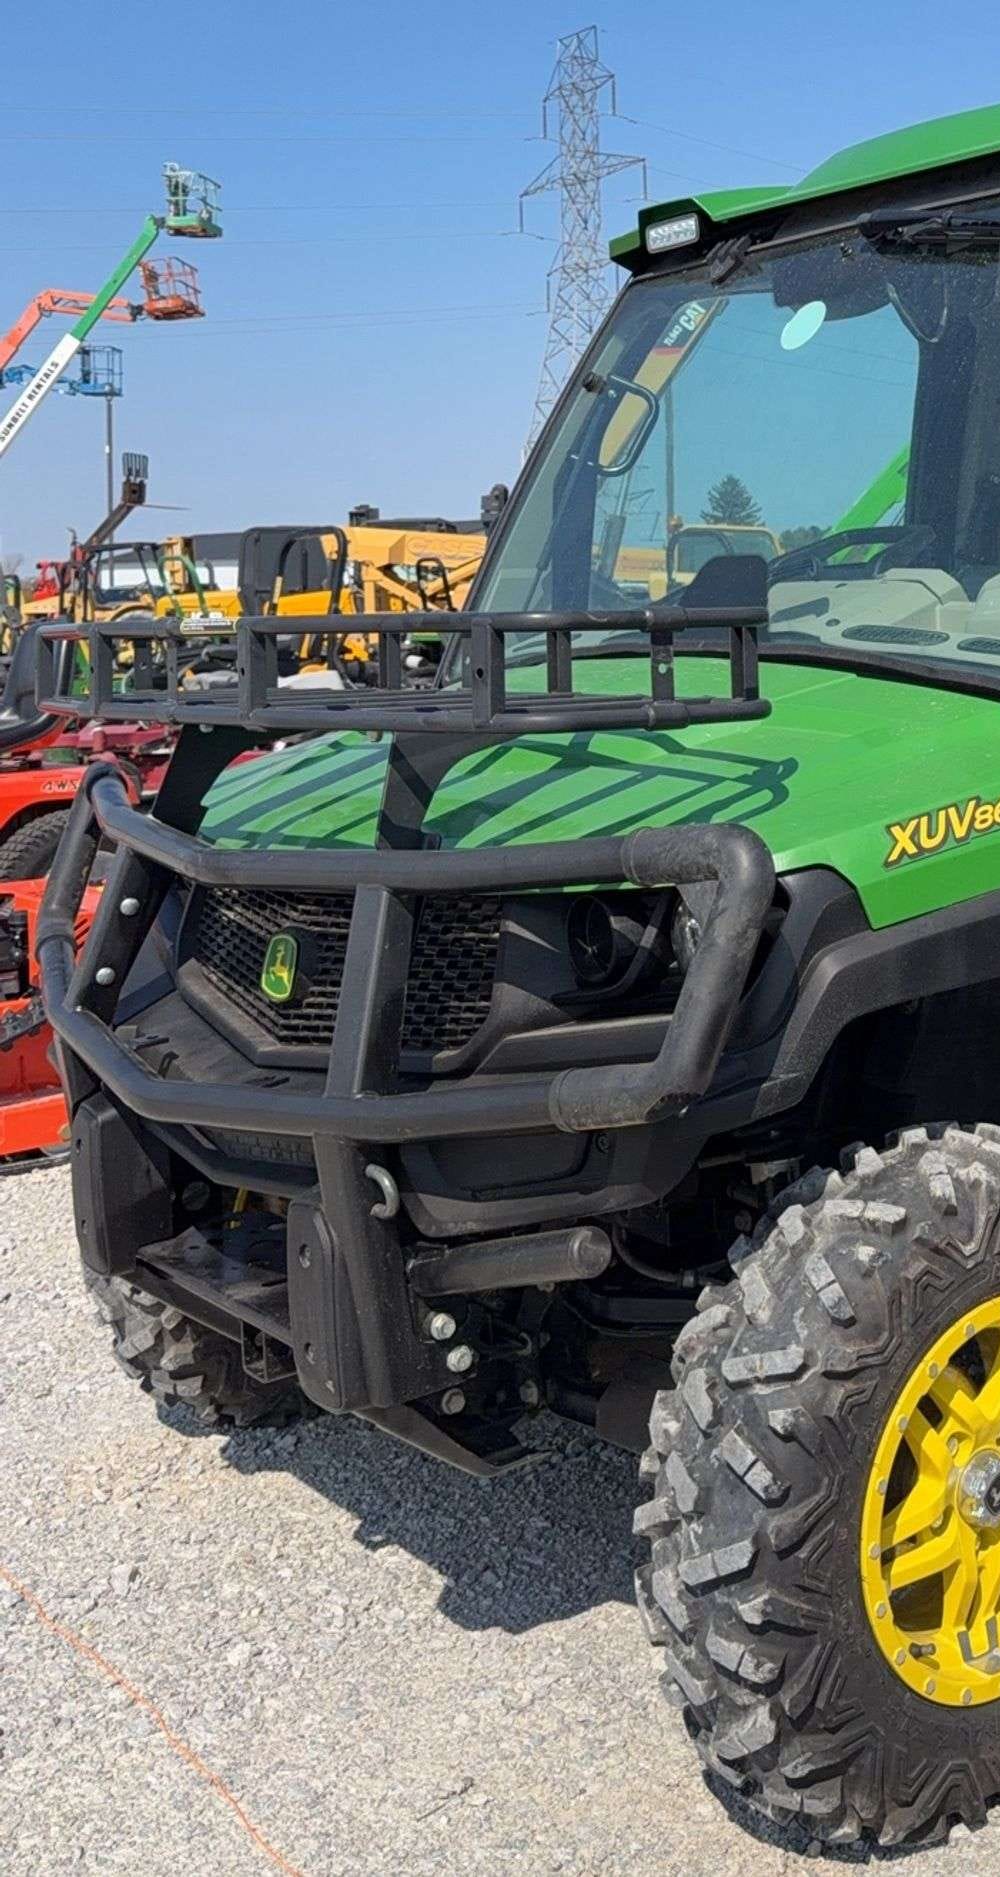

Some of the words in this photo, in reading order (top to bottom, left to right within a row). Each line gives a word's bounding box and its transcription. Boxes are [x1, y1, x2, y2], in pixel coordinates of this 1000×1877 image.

[679, 303, 706, 331] CAT
[0, 402, 29, 442] SUNBELT
[26, 361, 60, 401] RENTALS
